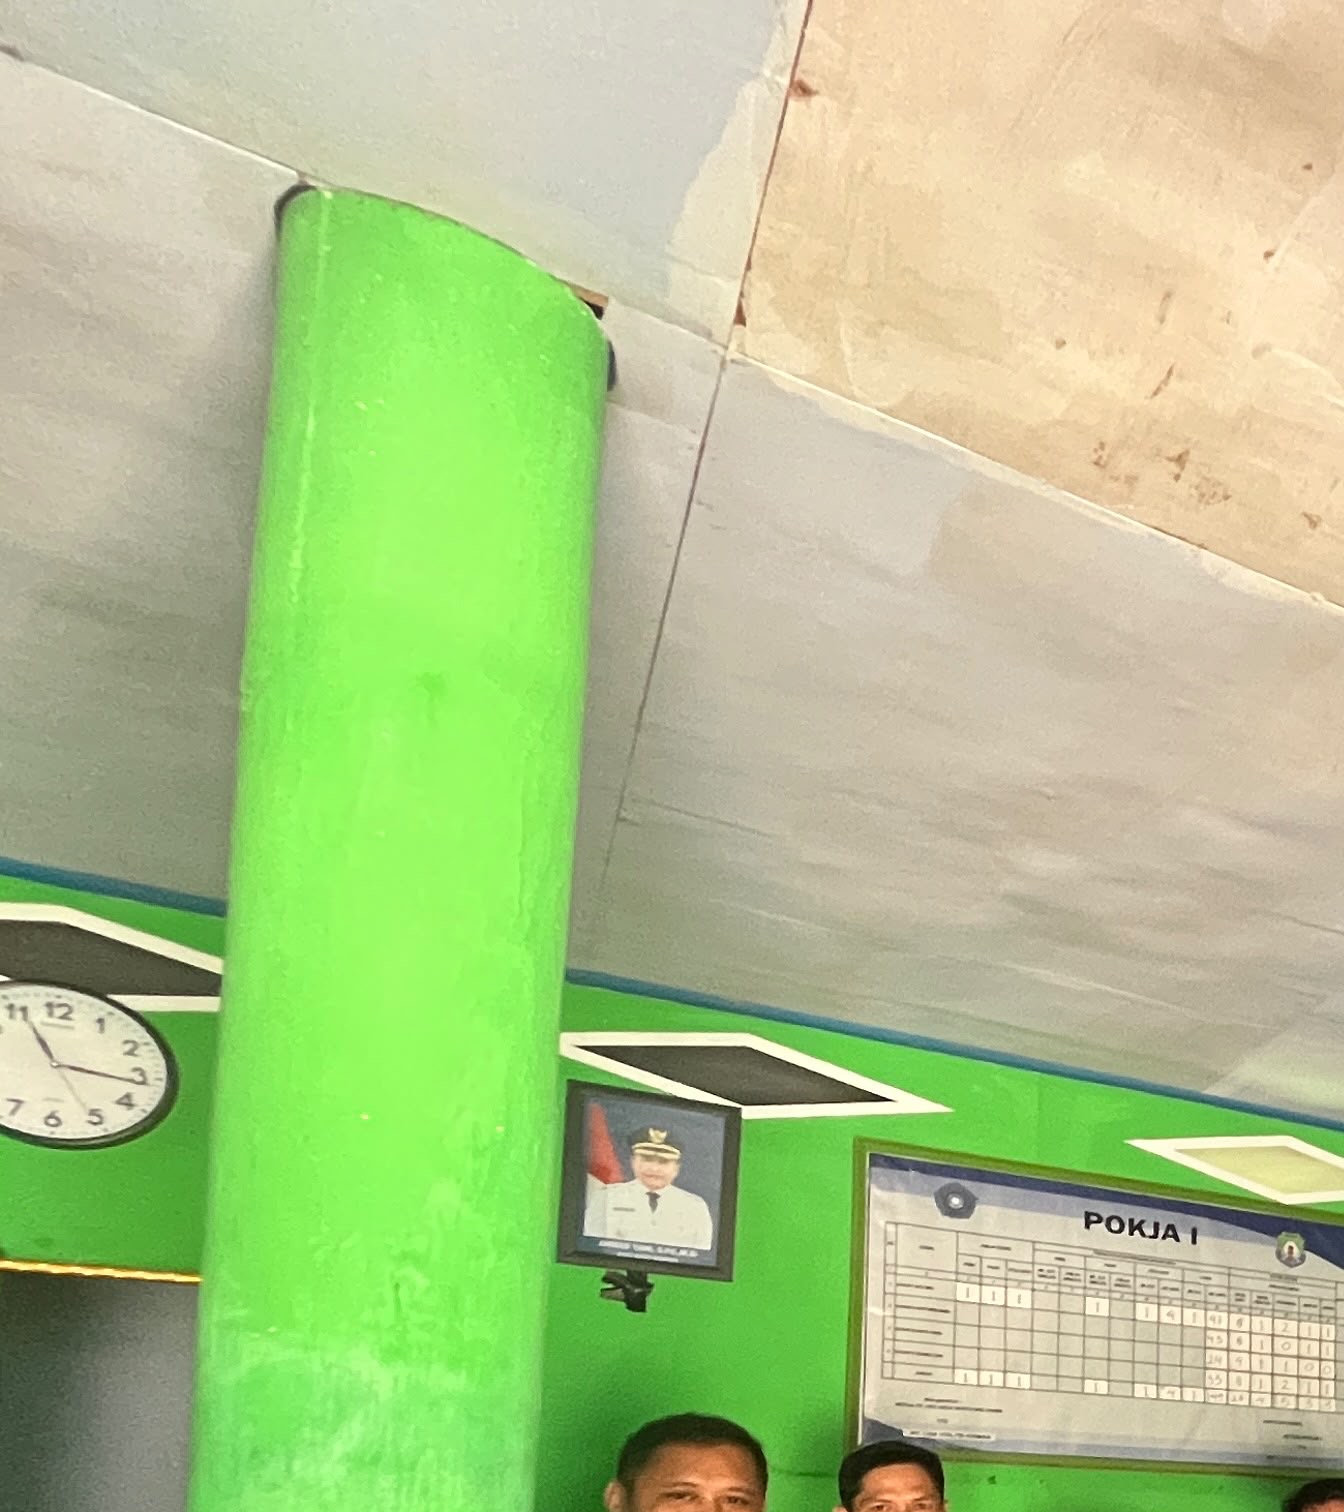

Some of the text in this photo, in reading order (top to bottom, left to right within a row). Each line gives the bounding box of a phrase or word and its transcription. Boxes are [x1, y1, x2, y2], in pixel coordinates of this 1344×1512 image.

[5, 1003, 29, 1022] 11
[44, 1001, 74, 1021] 12
[95, 1017, 105, 1034] 1
[122, 1040, 140, 1057] 2
[131, 1067, 148, 1086] 3
[5, 1098, 25, 1117] 7
[115, 1092, 136, 1111] 4
[43, 1110, 63, 1128] 6
[87, 1108, 104, 1126] 5
[1084, 1210, 1198, 1245] POKJA I
